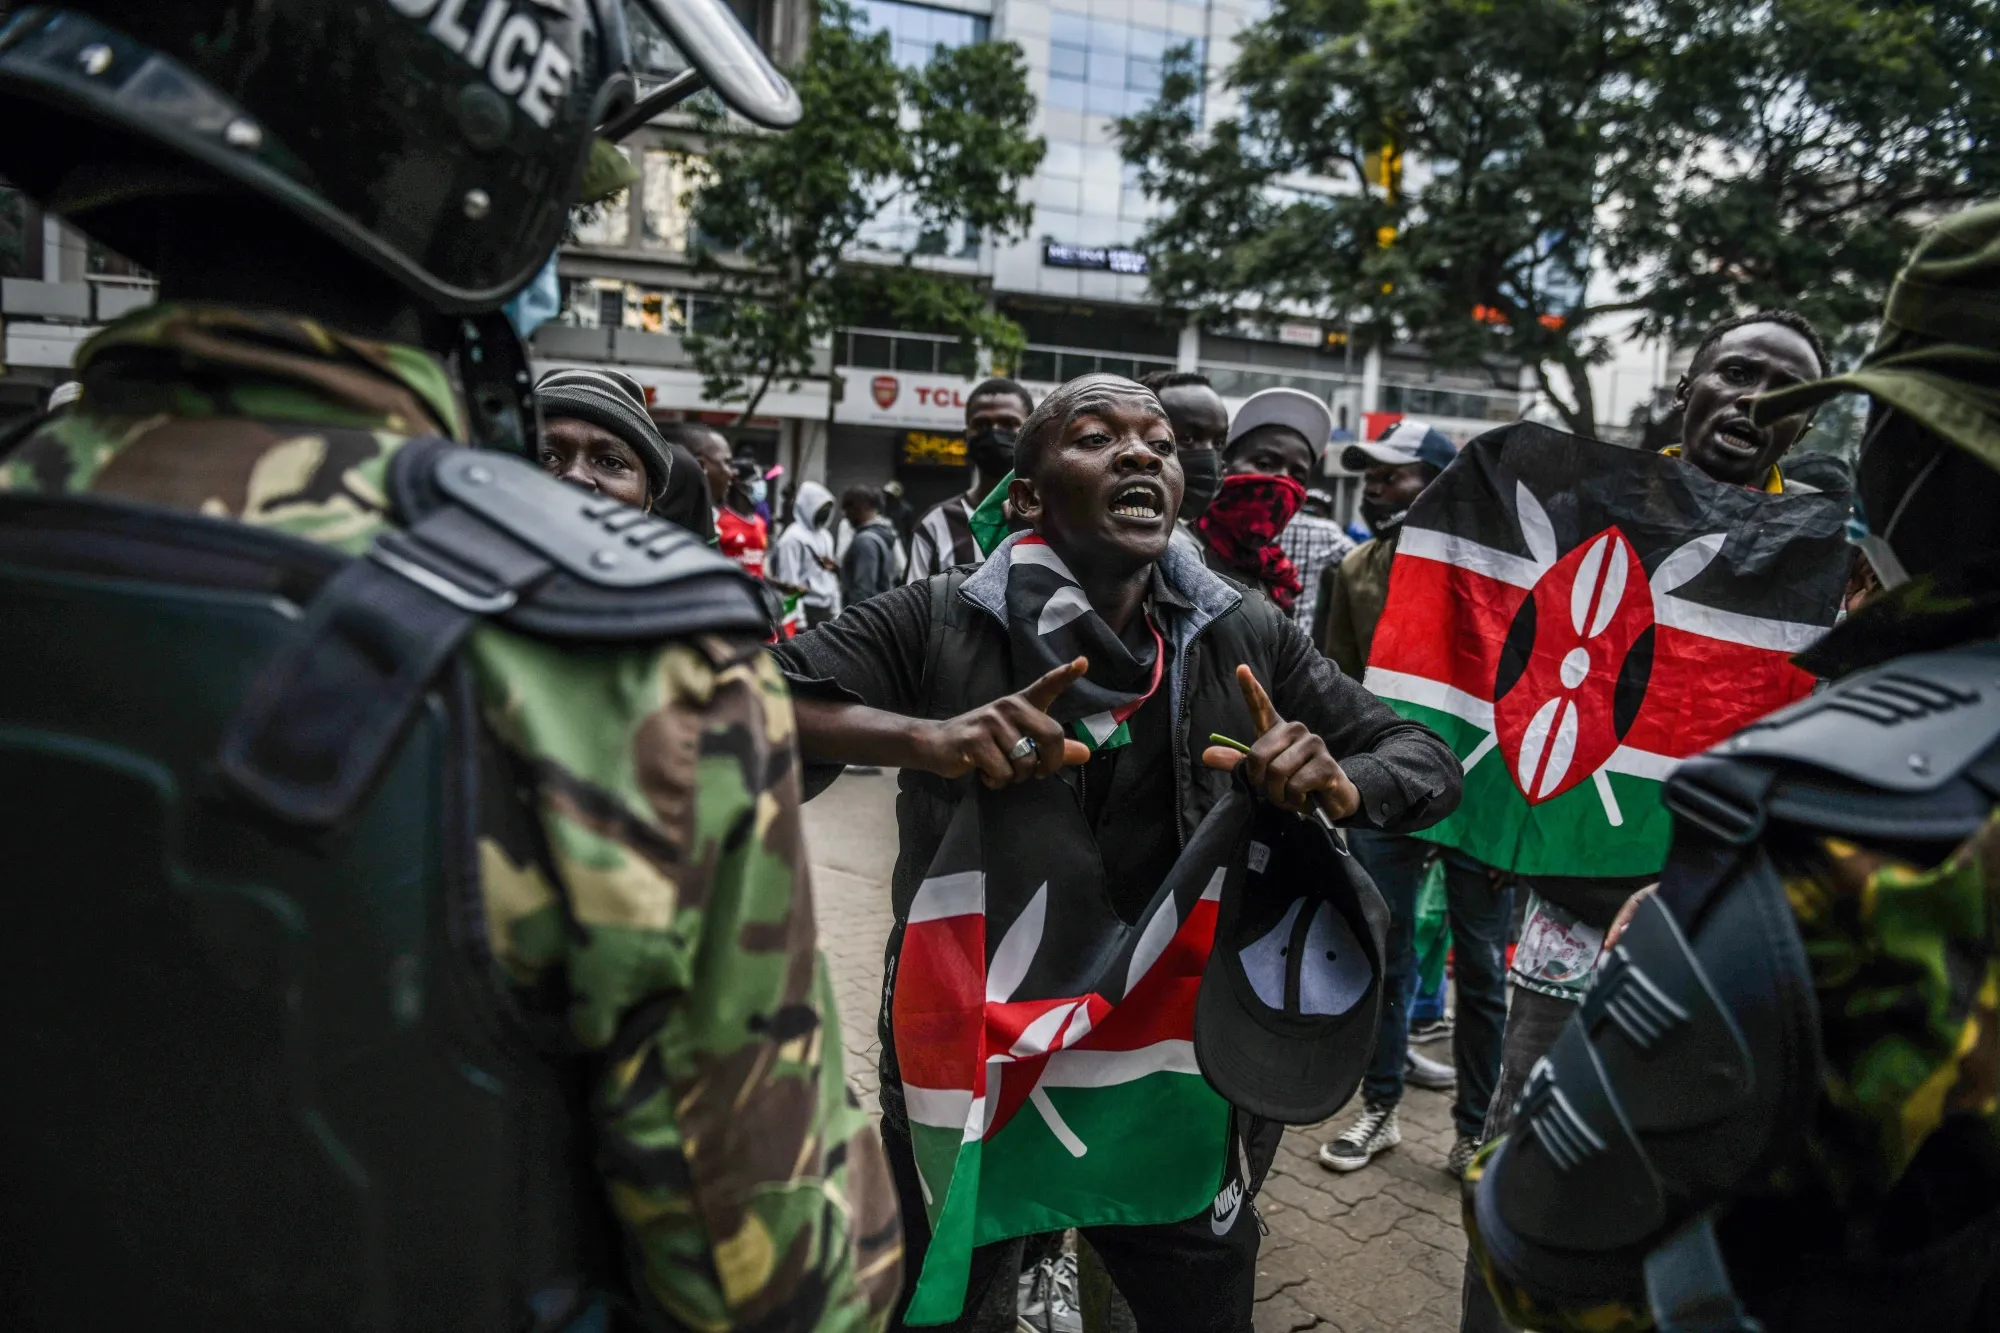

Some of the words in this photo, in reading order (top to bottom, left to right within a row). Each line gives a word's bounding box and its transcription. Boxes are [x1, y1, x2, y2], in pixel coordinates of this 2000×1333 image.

[386, 0, 571, 129] LICE
[914, 386, 965, 408] TCL
[1213, 1178, 1240, 1219] NIKE
